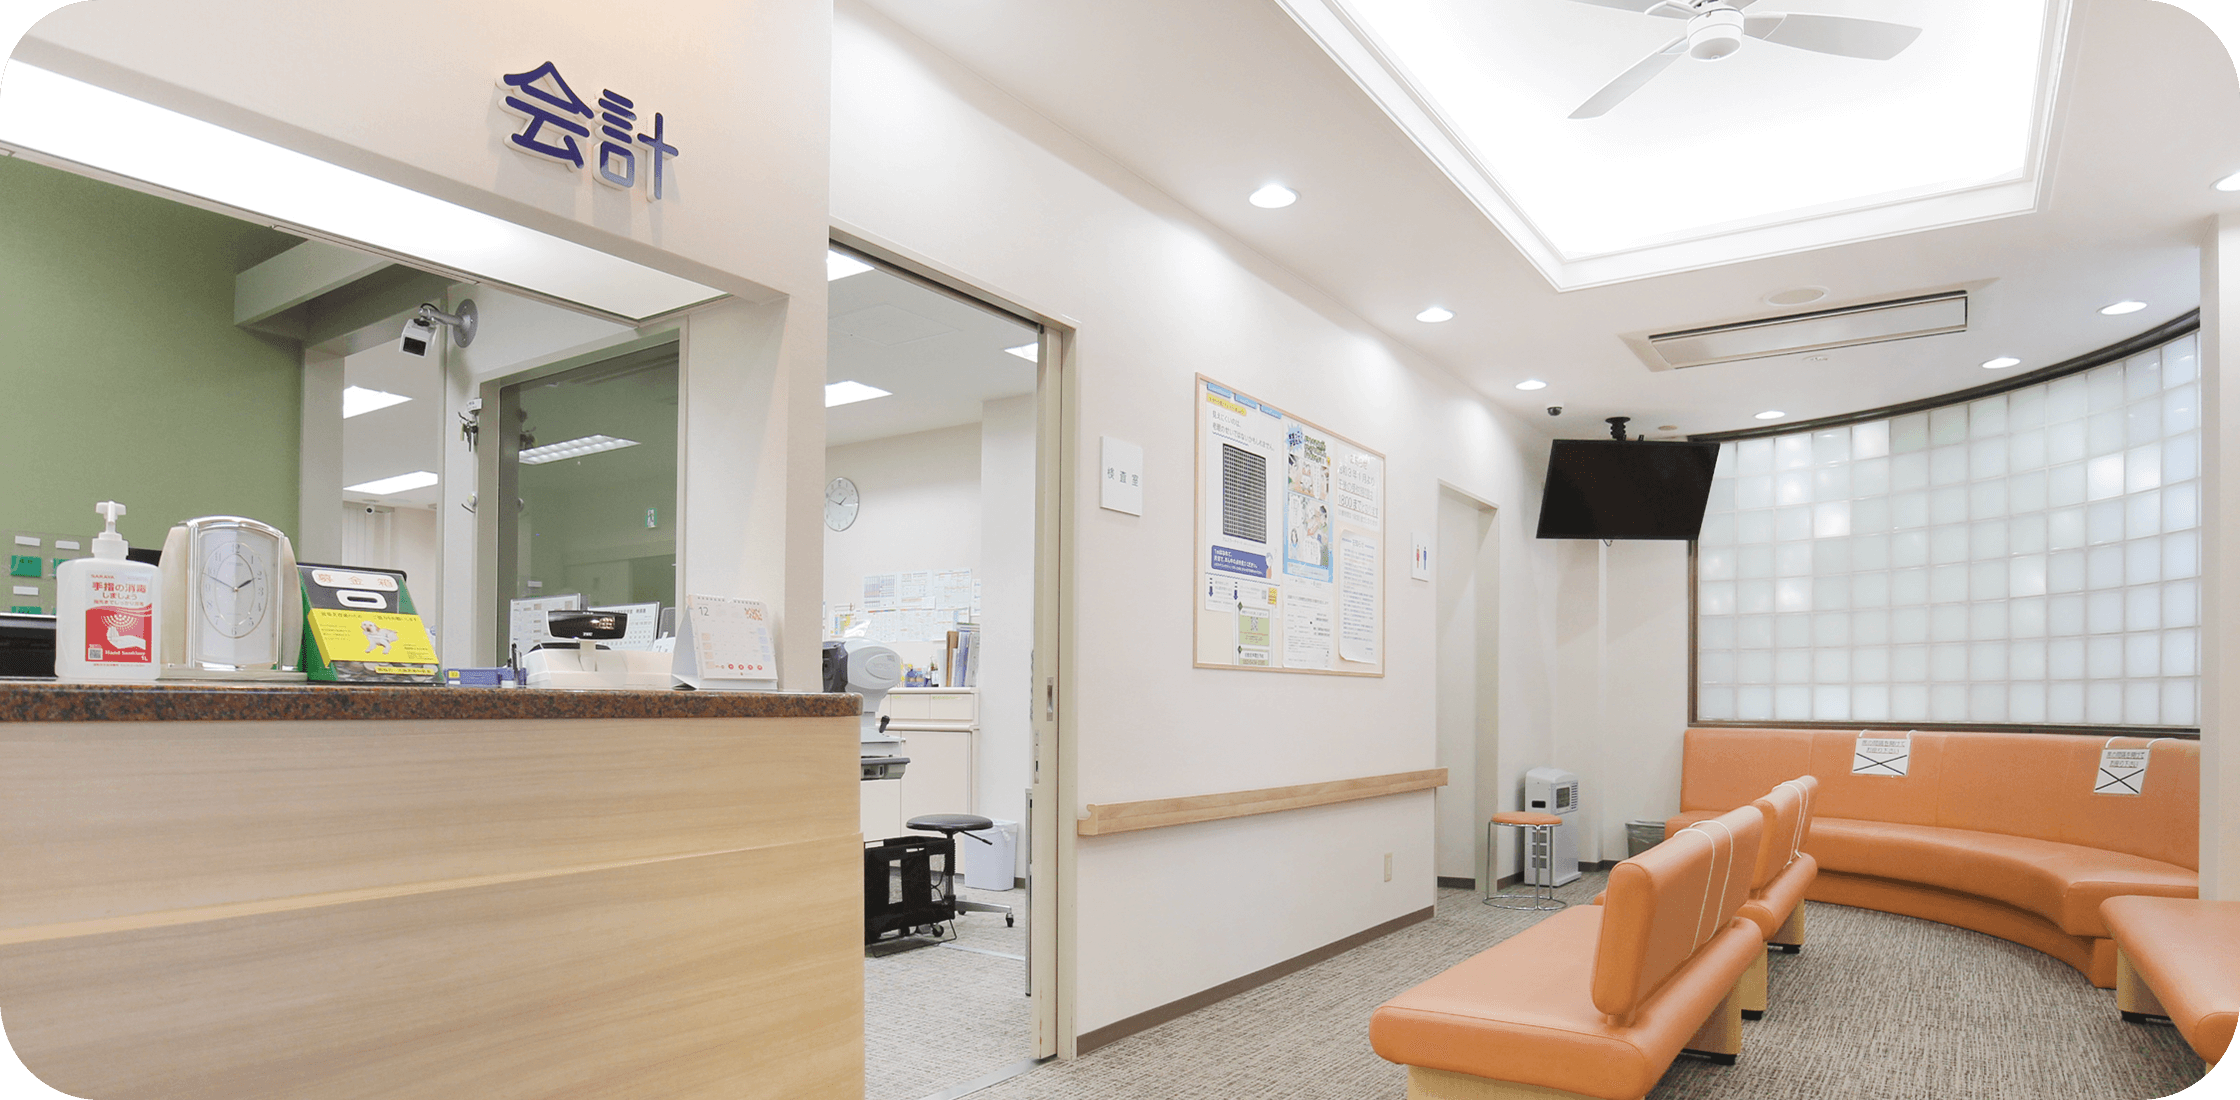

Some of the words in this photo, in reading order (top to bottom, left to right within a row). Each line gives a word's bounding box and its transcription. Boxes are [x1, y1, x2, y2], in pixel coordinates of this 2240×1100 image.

[502, 61, 679, 200] 会計
[317, 573, 394, 588] 募金箱
[92, 581, 147, 593] 手指の消毒
[102, 592, 138, 600] しましょう
[698, 606, 710, 616] 12
